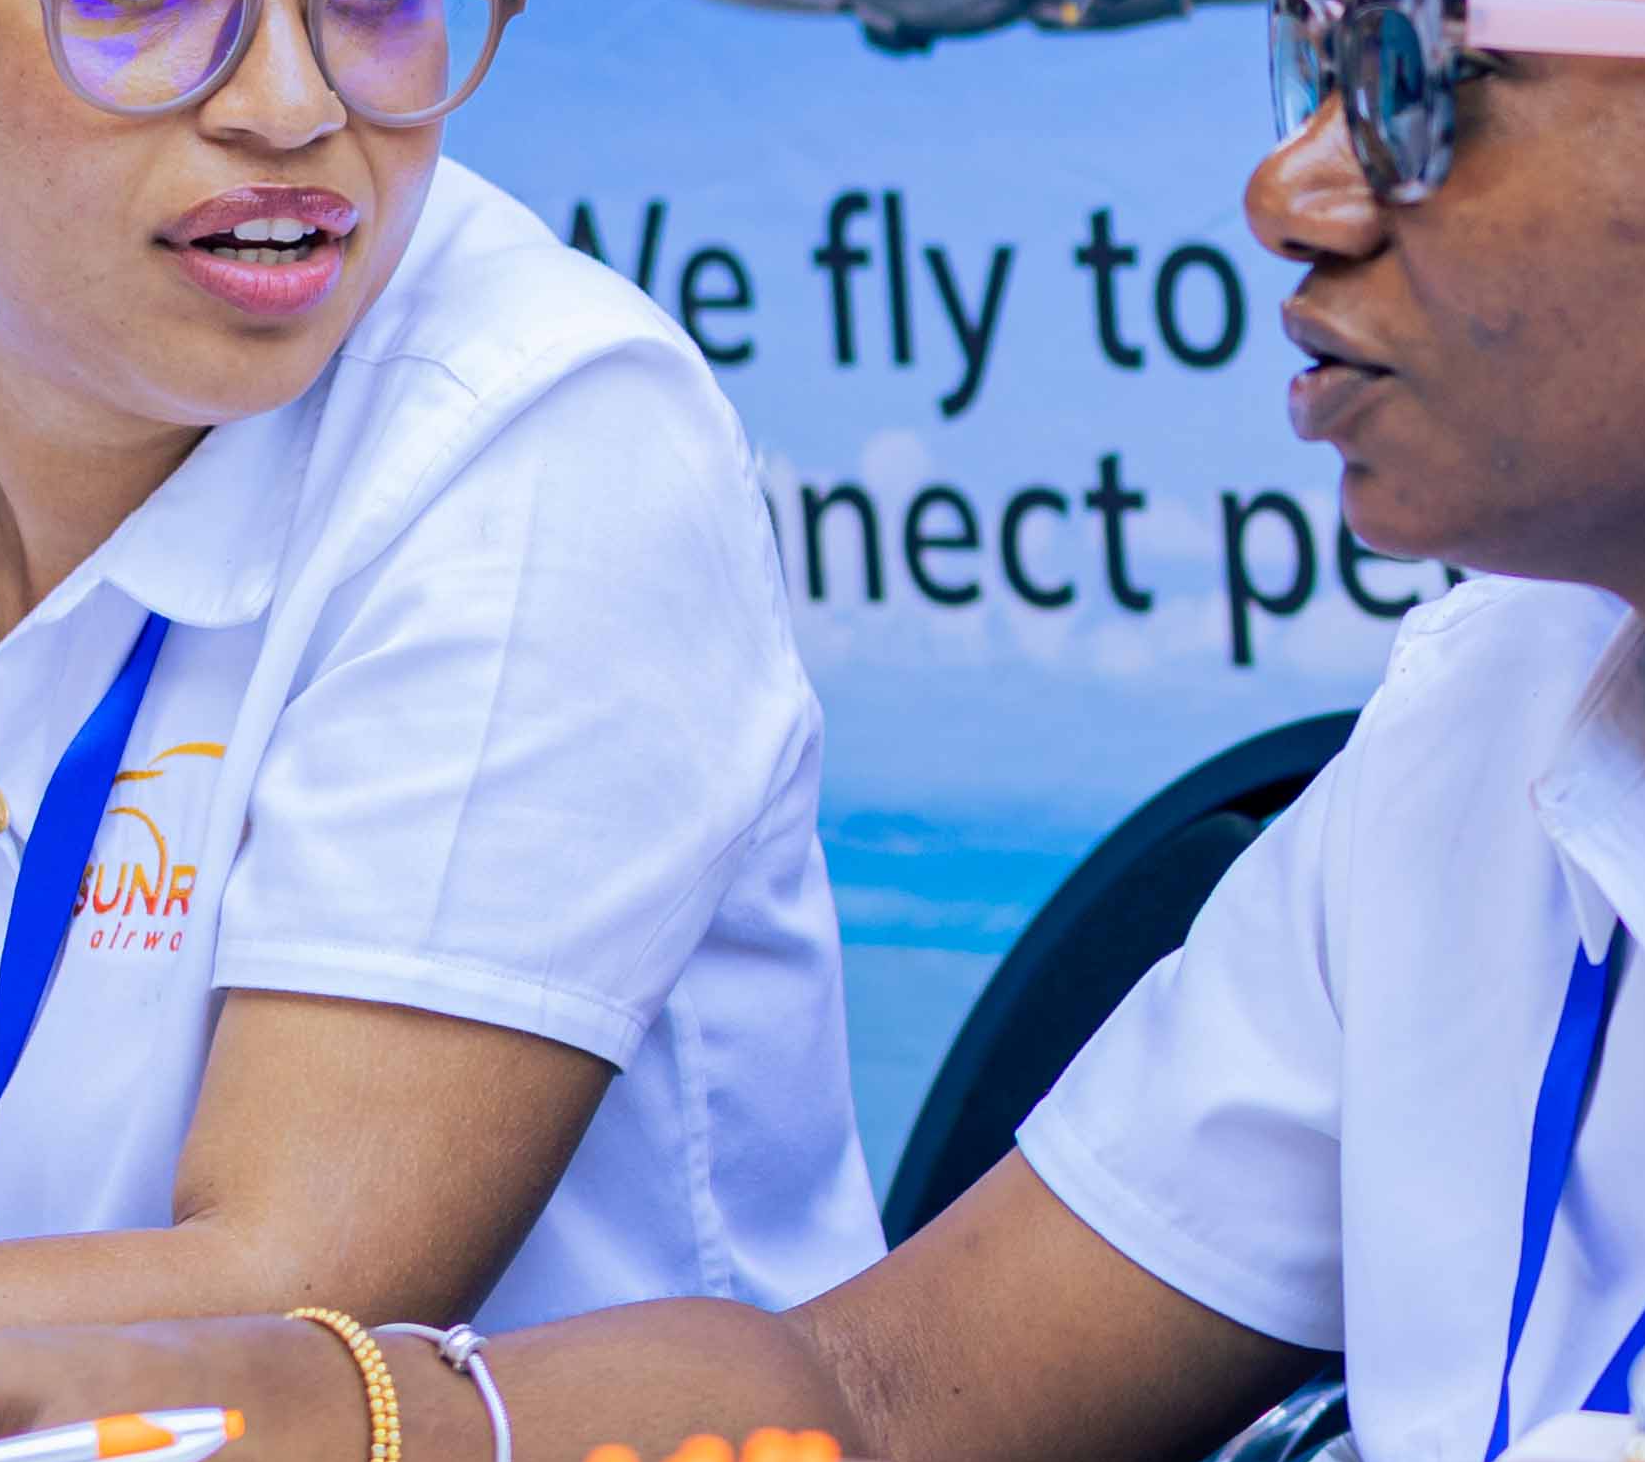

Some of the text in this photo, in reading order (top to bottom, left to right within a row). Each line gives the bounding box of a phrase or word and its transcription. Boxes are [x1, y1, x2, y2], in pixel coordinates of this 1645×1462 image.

[813, 189, 1015, 418] fly
[1073, 207, 1246, 371] to
[1222, 490, 1463, 667] pe
